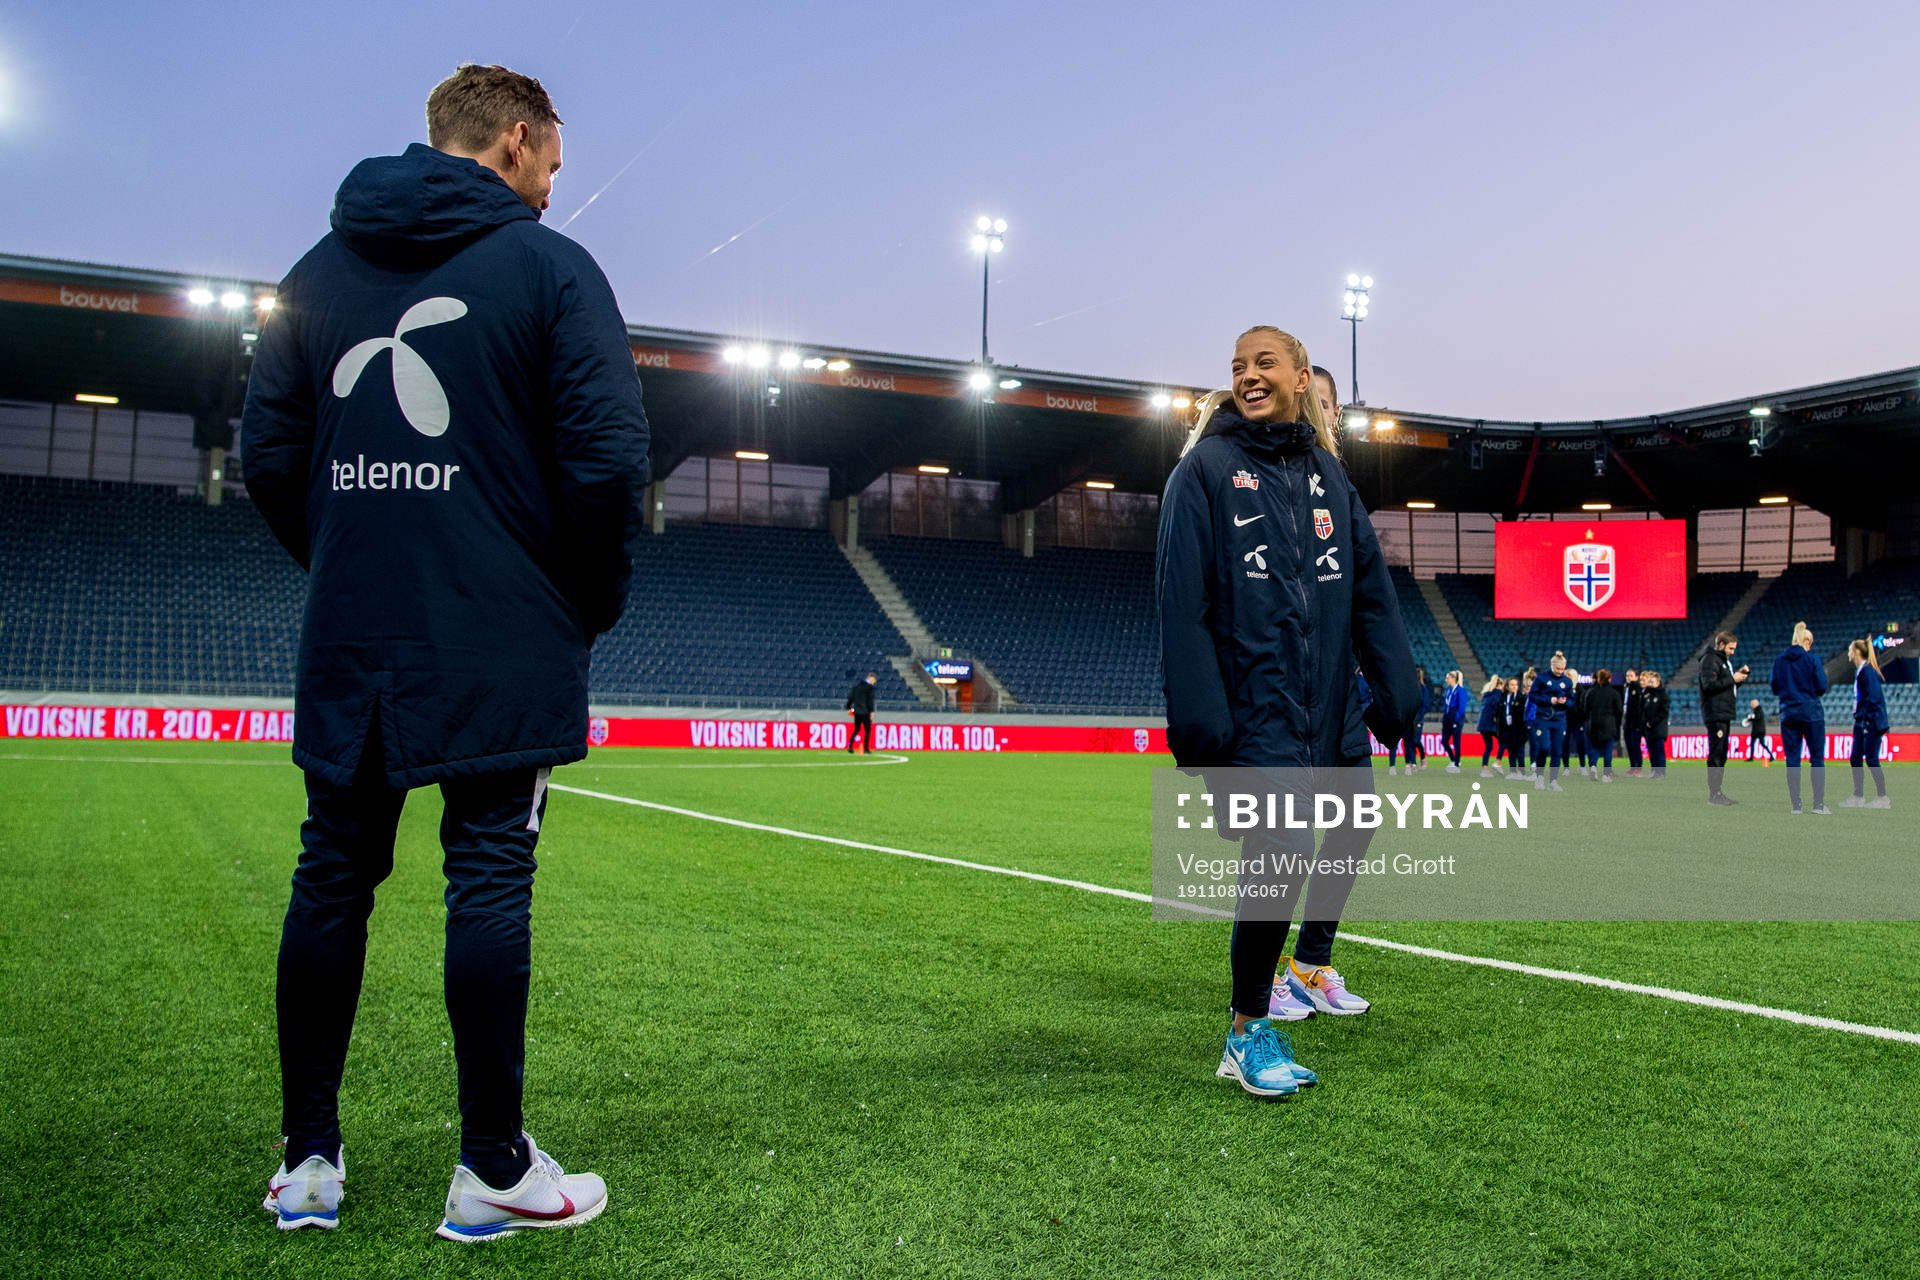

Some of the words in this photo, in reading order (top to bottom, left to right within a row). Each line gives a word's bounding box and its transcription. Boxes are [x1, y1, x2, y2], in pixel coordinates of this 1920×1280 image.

[60, 286, 138, 312] bouvet
[634, 351, 670, 369] uvet
[1046, 391, 1098, 412] bouvet
[331, 454, 460, 491] telenor
[1246, 570, 1269, 580] telenor
[1318, 571, 1342, 582] telenor
[938, 663, 970, 676] telenor
[5, 706, 107, 738] VOKSNE
[114, 708, 156, 738] KR.
[249, 711, 295, 741] BAR
[690, 720, 767, 748] VOKSNE
[773, 722, 805, 748] KR.
[875, 725, 924, 750] BARN
[930, 726, 959, 750] KR.
[963, 727, 1009, 752] 100,-
[1671, 735, 1710, 758] VOKSN
